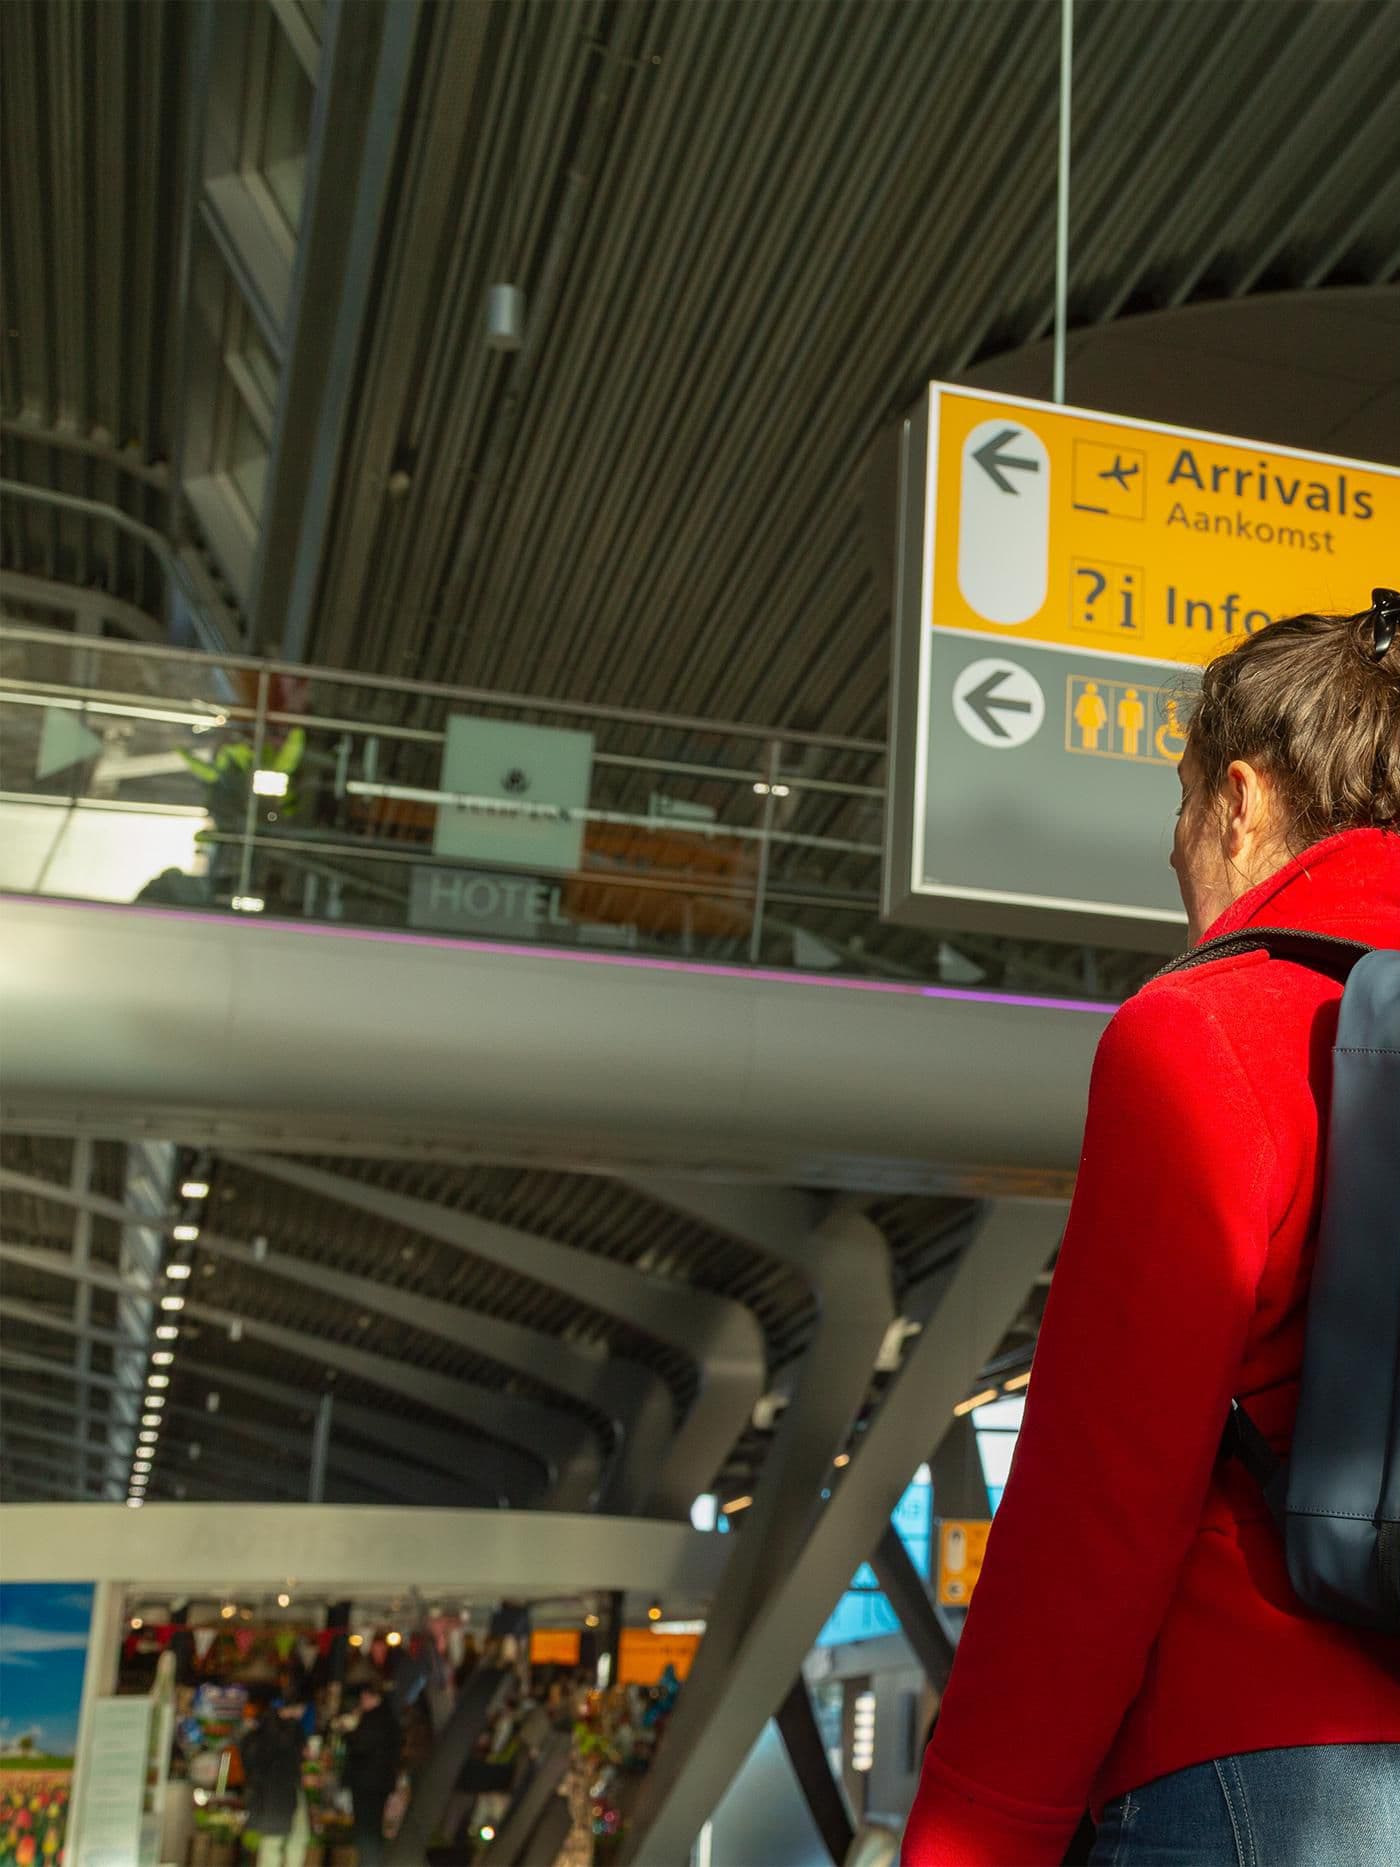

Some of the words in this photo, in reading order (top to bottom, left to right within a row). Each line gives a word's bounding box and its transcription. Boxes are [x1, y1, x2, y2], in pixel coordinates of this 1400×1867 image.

[1167, 449, 1374, 520] Arrivals
[1167, 502, 1335, 555] Aankomst
[431, 876, 570, 926] HOTEL
